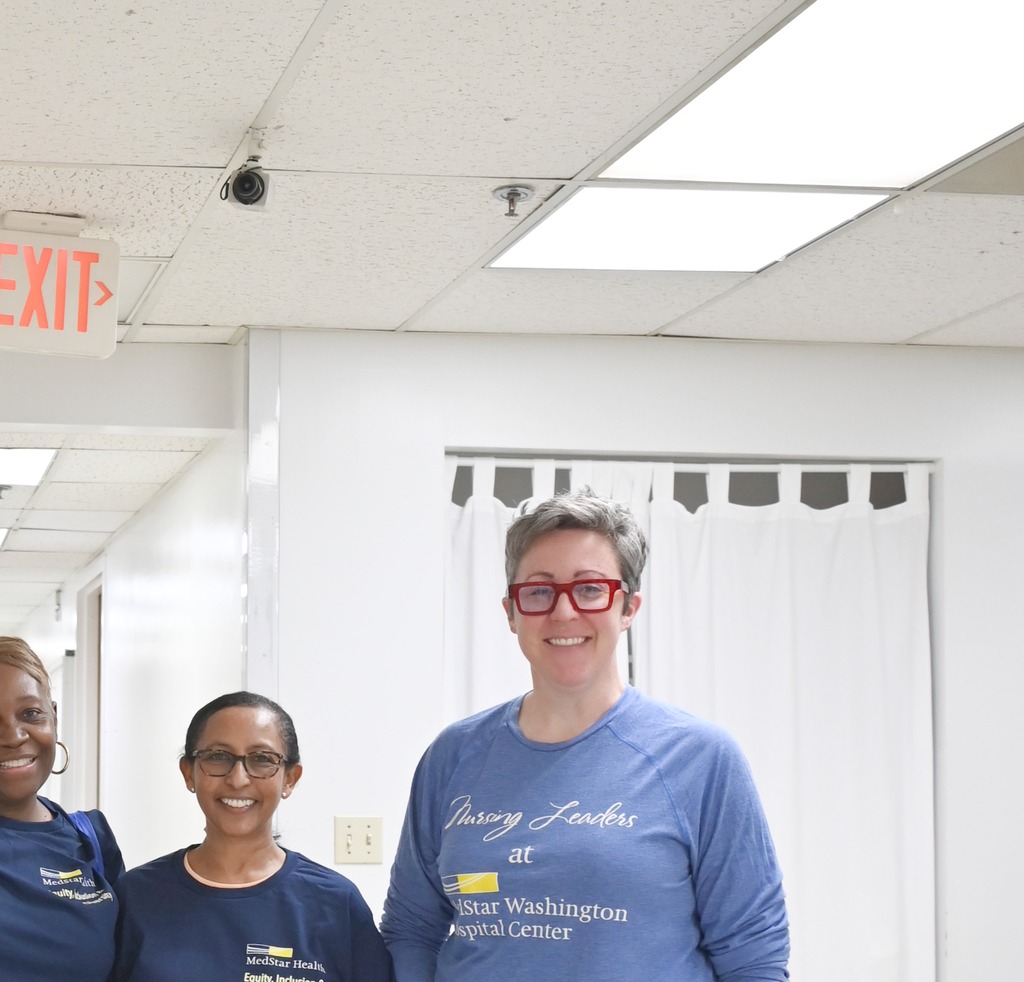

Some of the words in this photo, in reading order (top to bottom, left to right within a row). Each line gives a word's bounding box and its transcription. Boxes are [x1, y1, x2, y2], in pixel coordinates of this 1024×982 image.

[445, 795, 523, 841] Nursing
[529, 801, 638, 831] Leaders
[508, 845, 534, 864] at
[504, 897, 628, 923] Washington
[508, 921, 573, 940] Center
[246, 956, 291, 968] MedStar
[293, 960, 326, 973] Health
